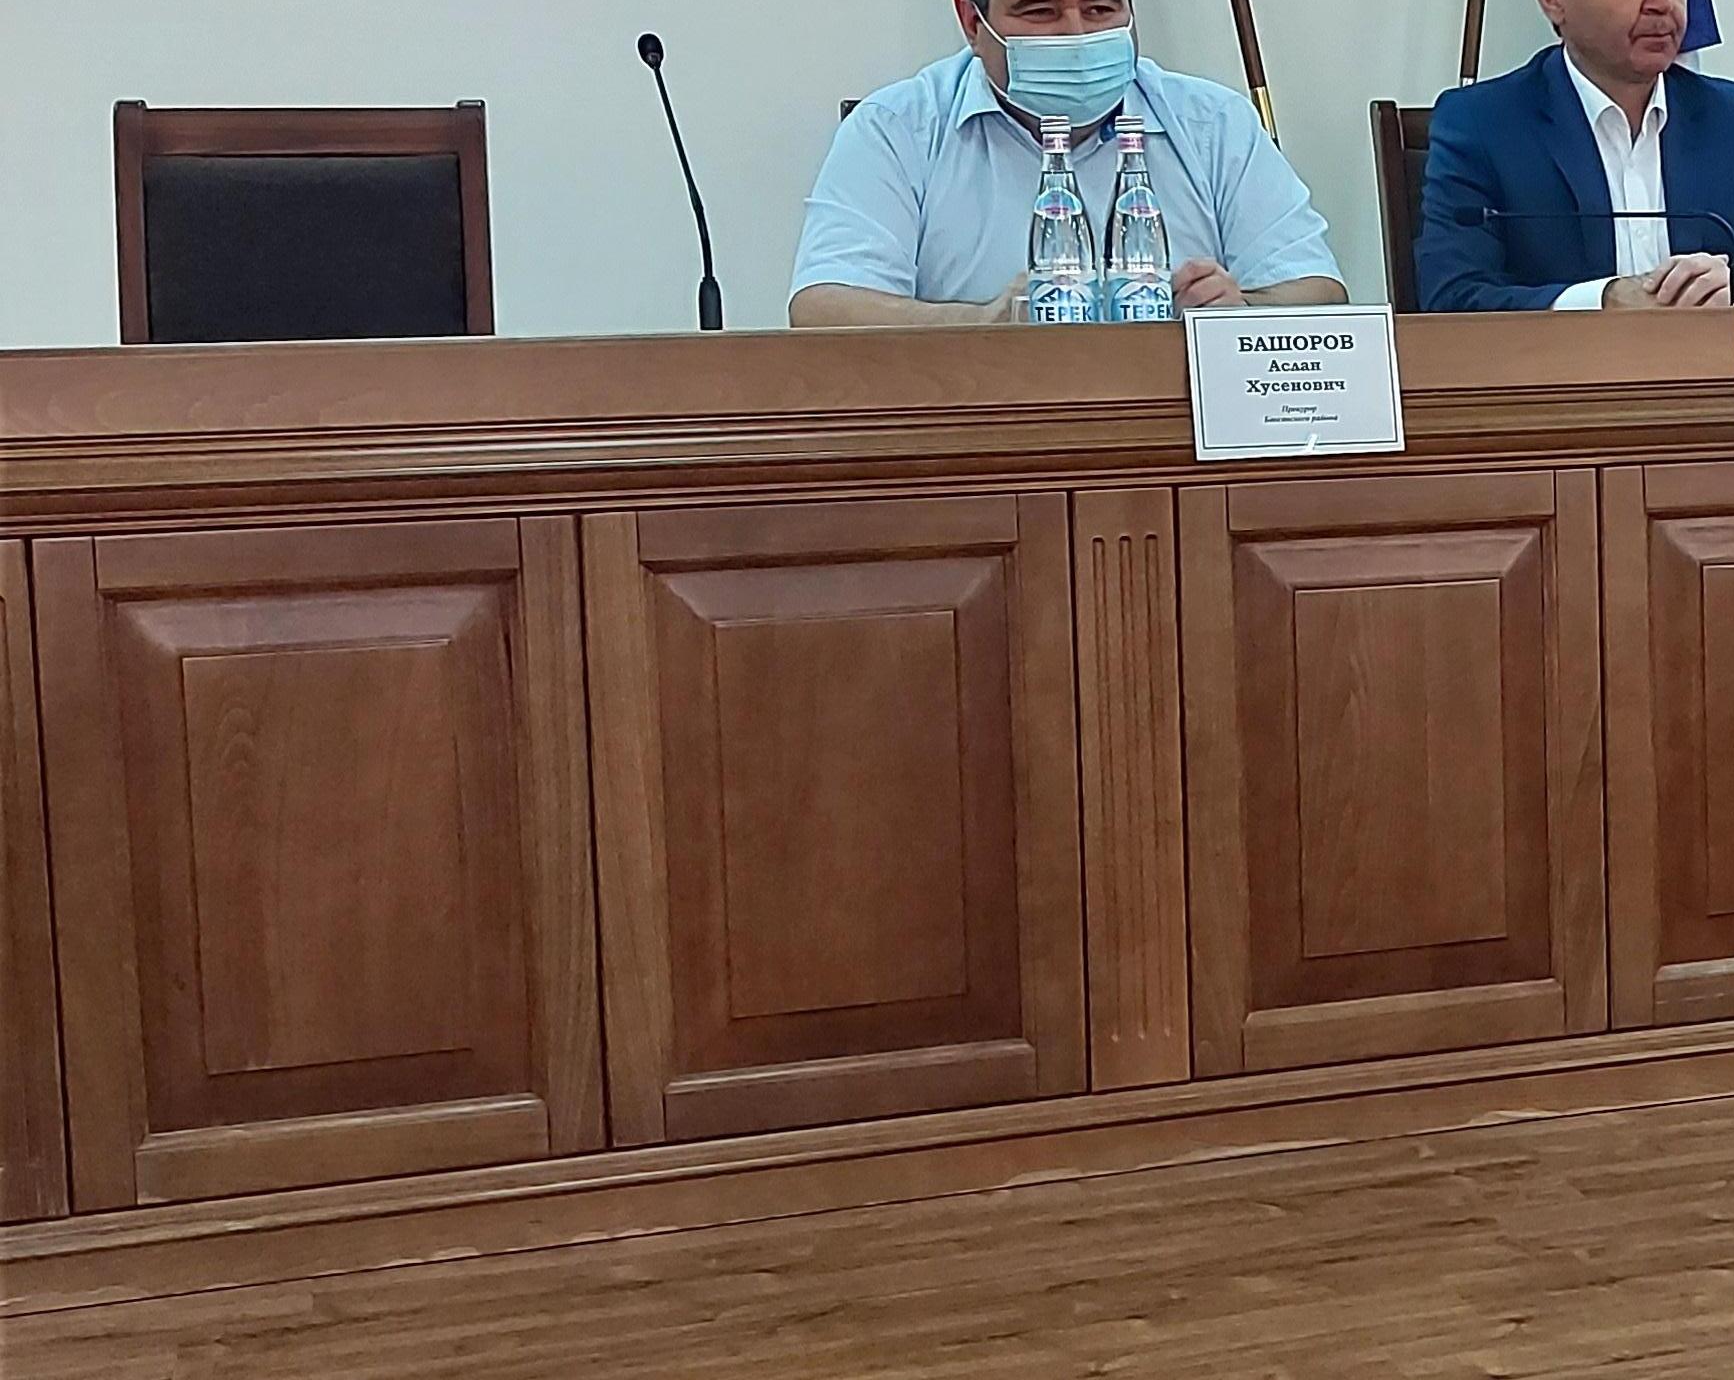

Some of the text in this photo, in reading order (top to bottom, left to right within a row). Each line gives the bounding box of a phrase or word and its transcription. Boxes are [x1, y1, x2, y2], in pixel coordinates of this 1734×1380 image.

[1035, 306, 1092, 321] ТЕРЕК
[1238, 334, 1355, 352] БАШОРОВ
[1268, 358, 1322, 373] Аслан
[1246, 379, 1346, 396] Хусенович
